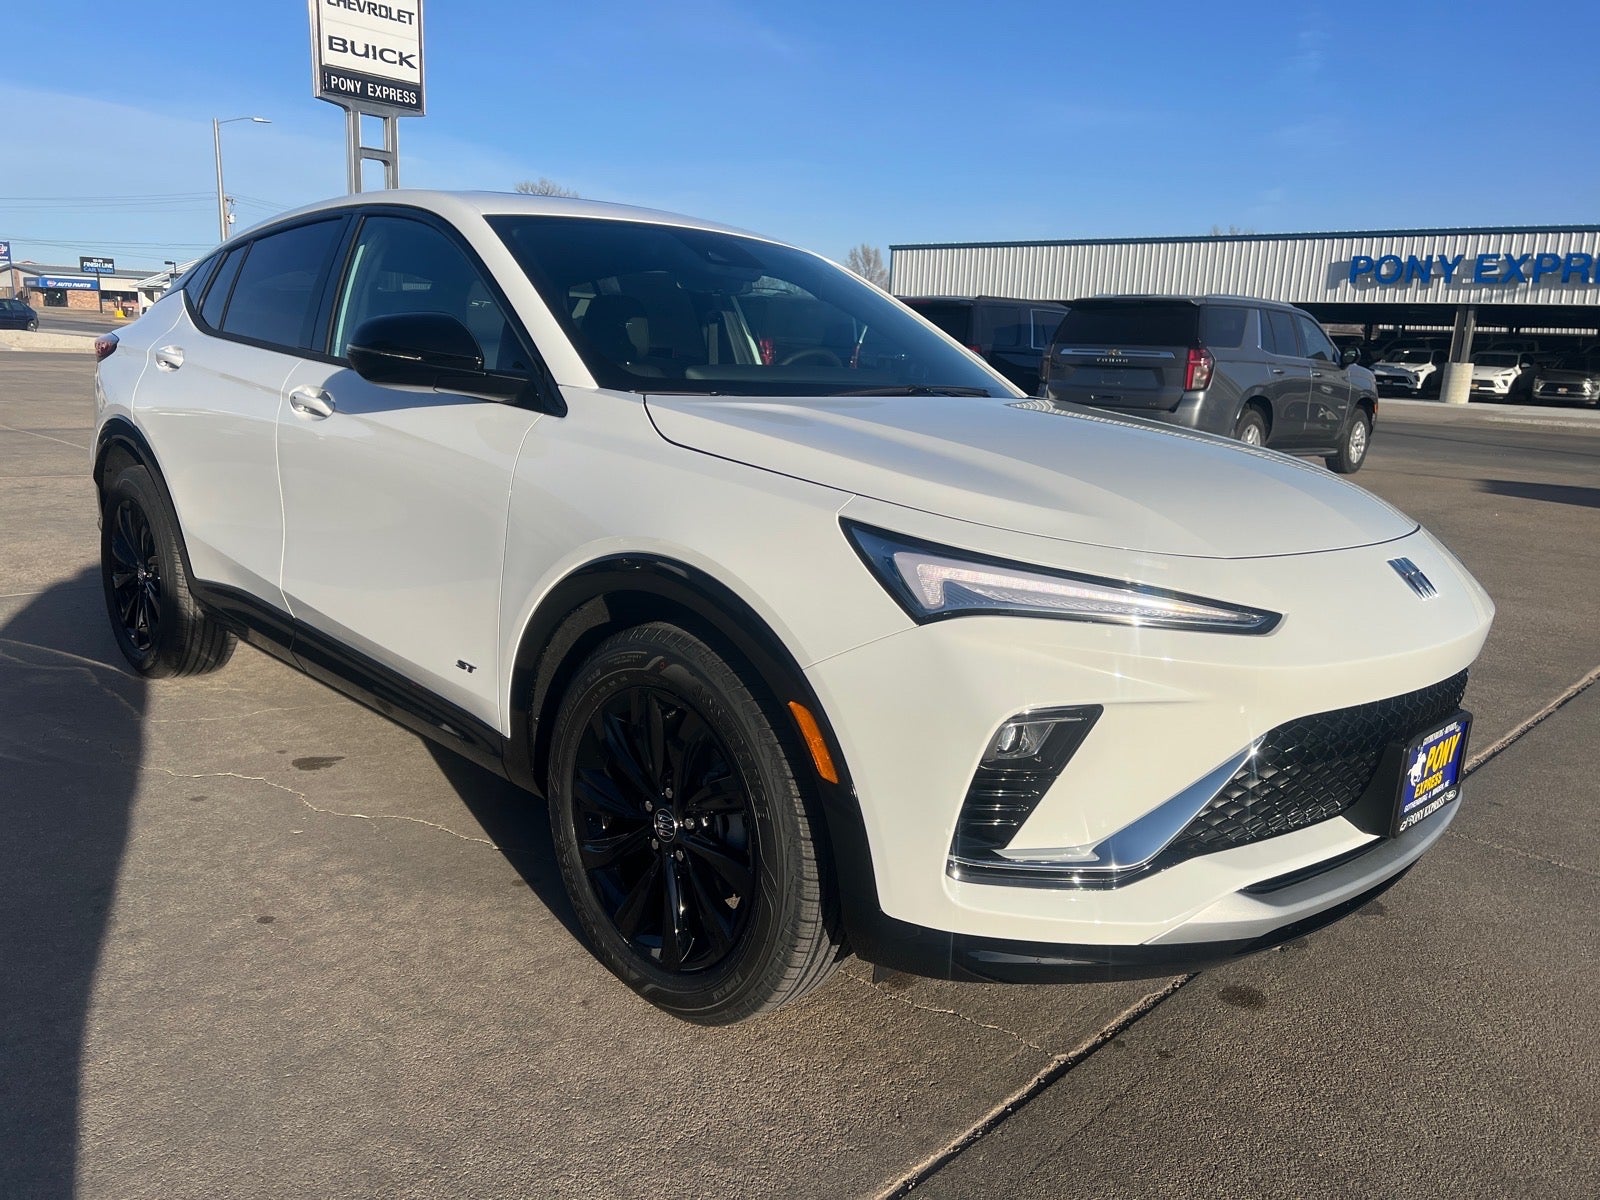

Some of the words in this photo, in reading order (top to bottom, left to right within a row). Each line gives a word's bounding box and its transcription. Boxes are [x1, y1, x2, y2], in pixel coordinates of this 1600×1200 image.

[328, 35, 417, 69] BUICK
[330, 75, 361, 94] PONY
[367, 83, 417, 105] EXPRESS
[1350, 254, 1464, 284] PONY
[1474, 253, 1600, 284] EXPR
[456, 659, 477, 673] ST
[1424, 732, 1461, 778] PONY
[1414, 770, 1443, 799] EXPRESS
